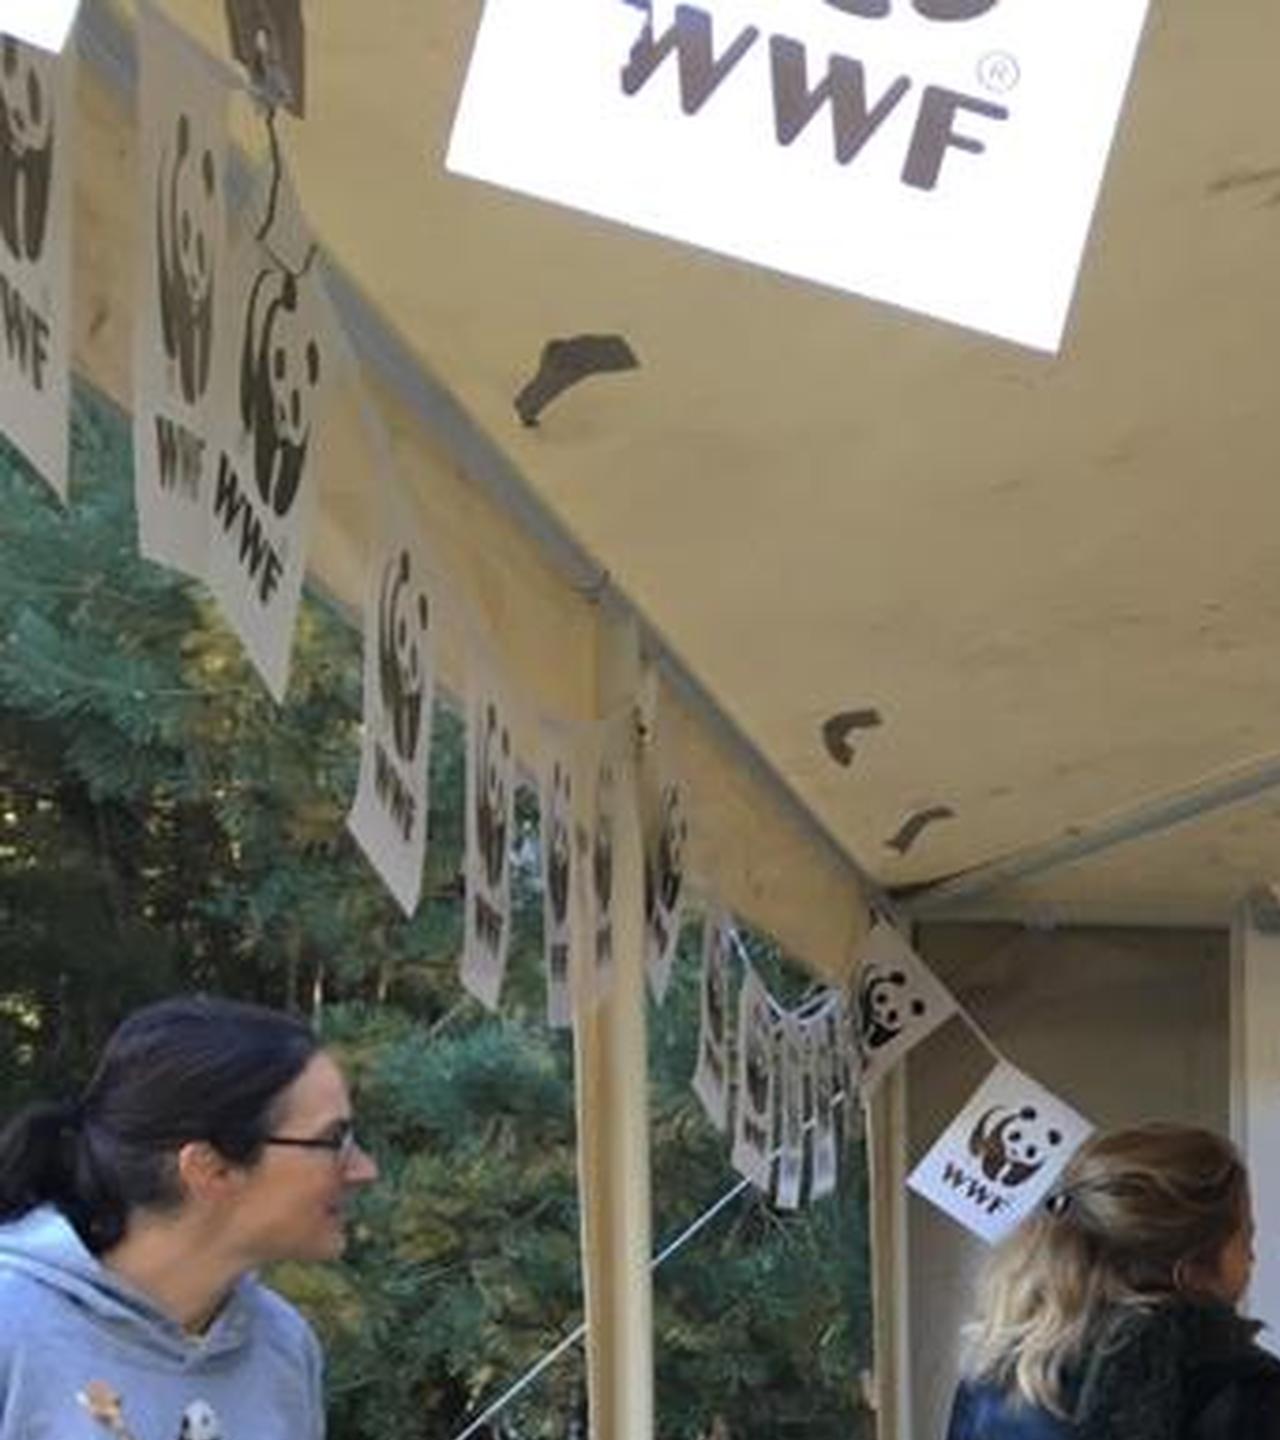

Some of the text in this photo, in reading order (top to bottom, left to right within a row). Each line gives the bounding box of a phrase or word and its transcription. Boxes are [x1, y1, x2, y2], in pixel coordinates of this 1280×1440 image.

[620, 0, 1010, 192] WWF
[213, 449, 284, 606] WWF
[942, 1162, 1012, 1215] WWF
